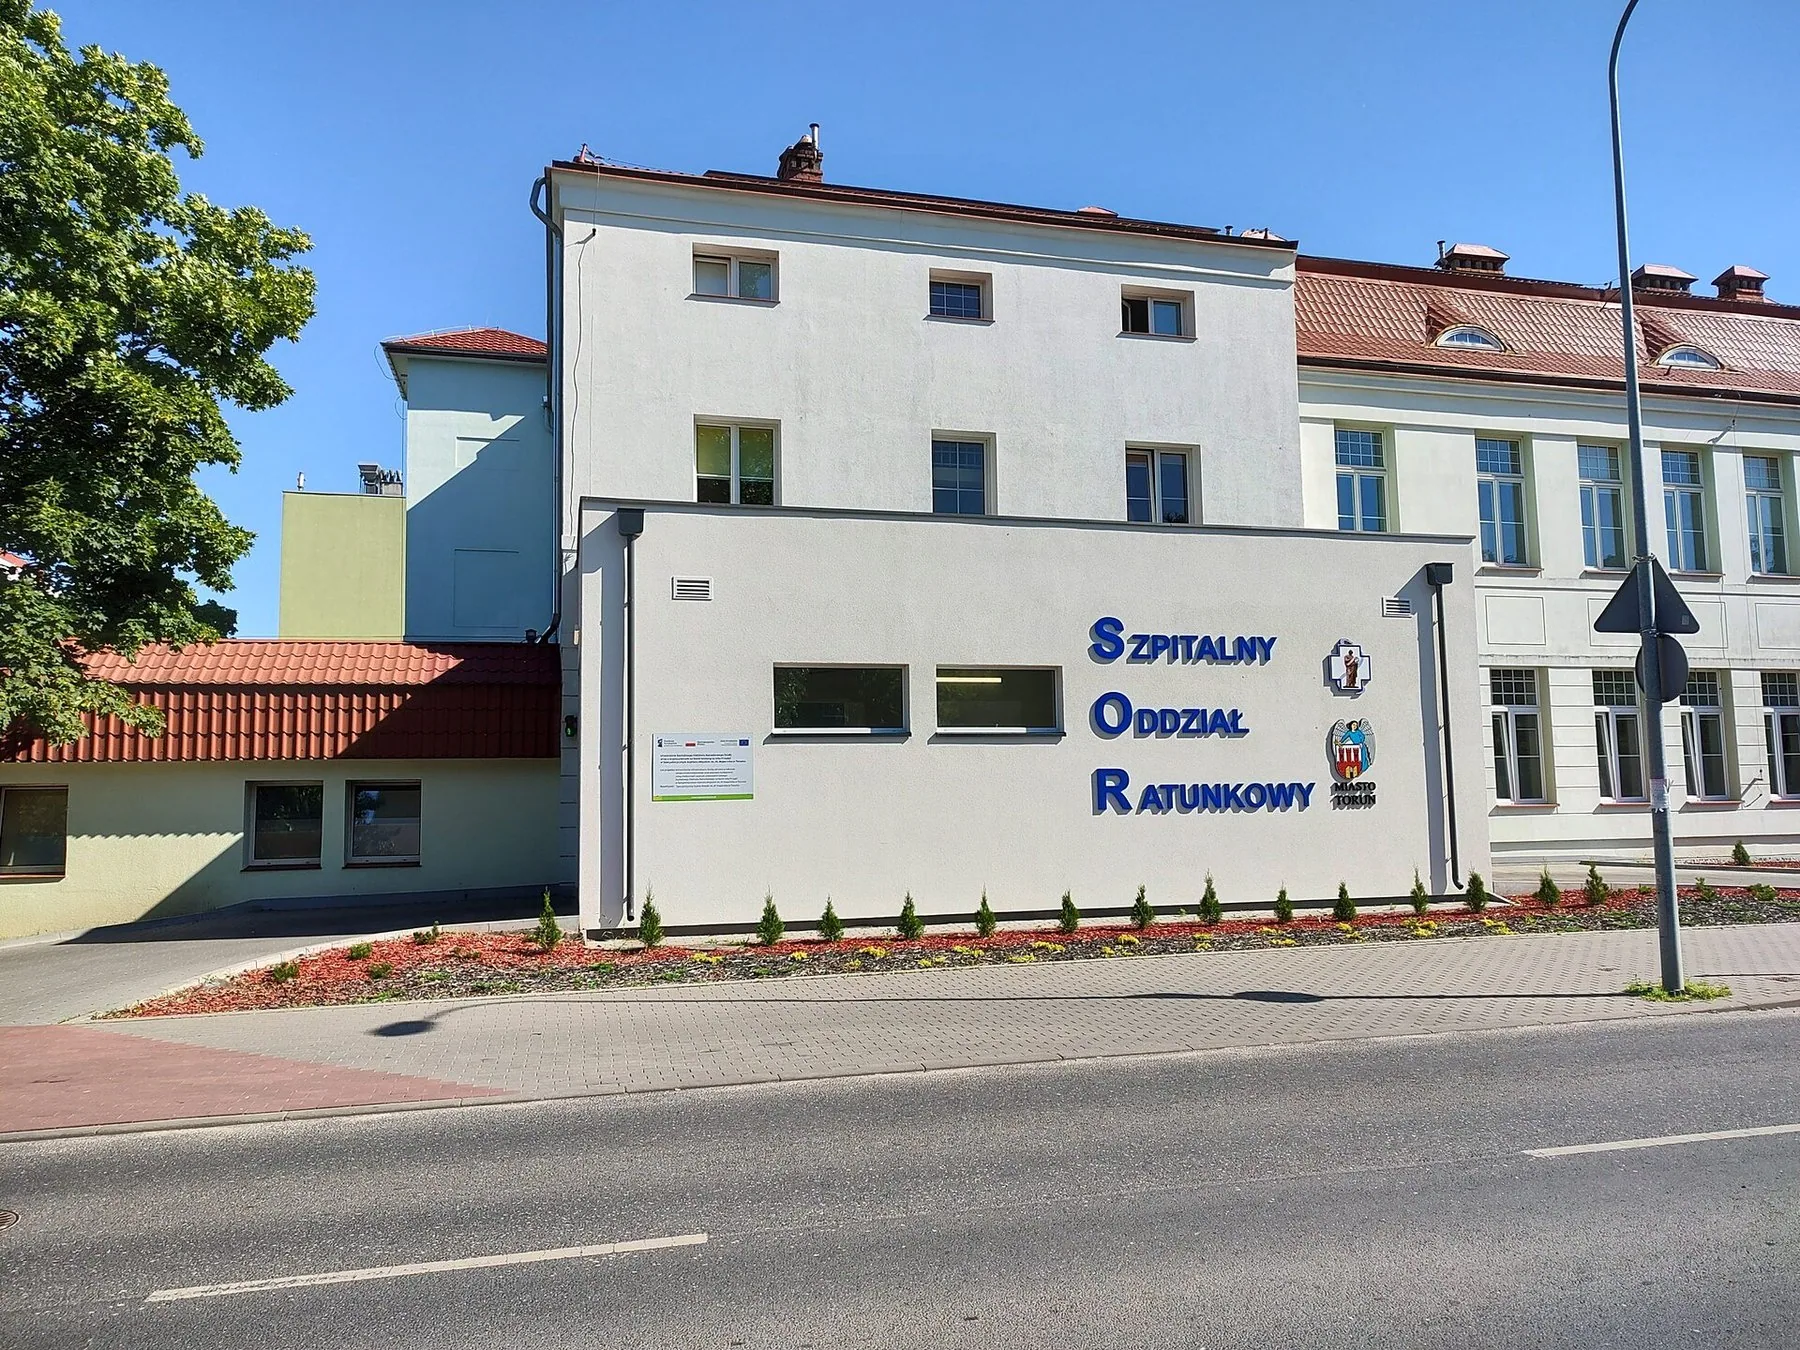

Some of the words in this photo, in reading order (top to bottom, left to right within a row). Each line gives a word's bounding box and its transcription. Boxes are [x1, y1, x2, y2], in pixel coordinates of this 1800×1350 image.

[1092, 617, 1276, 661] SZPITALNY
[1094, 691, 1249, 735] ODDZIAŁ
[1096, 768, 1315, 811] RATUNKOWY
[1334, 781, 1376, 791] MIASTO
[1335, 791, 1376, 805] TORUŃ
